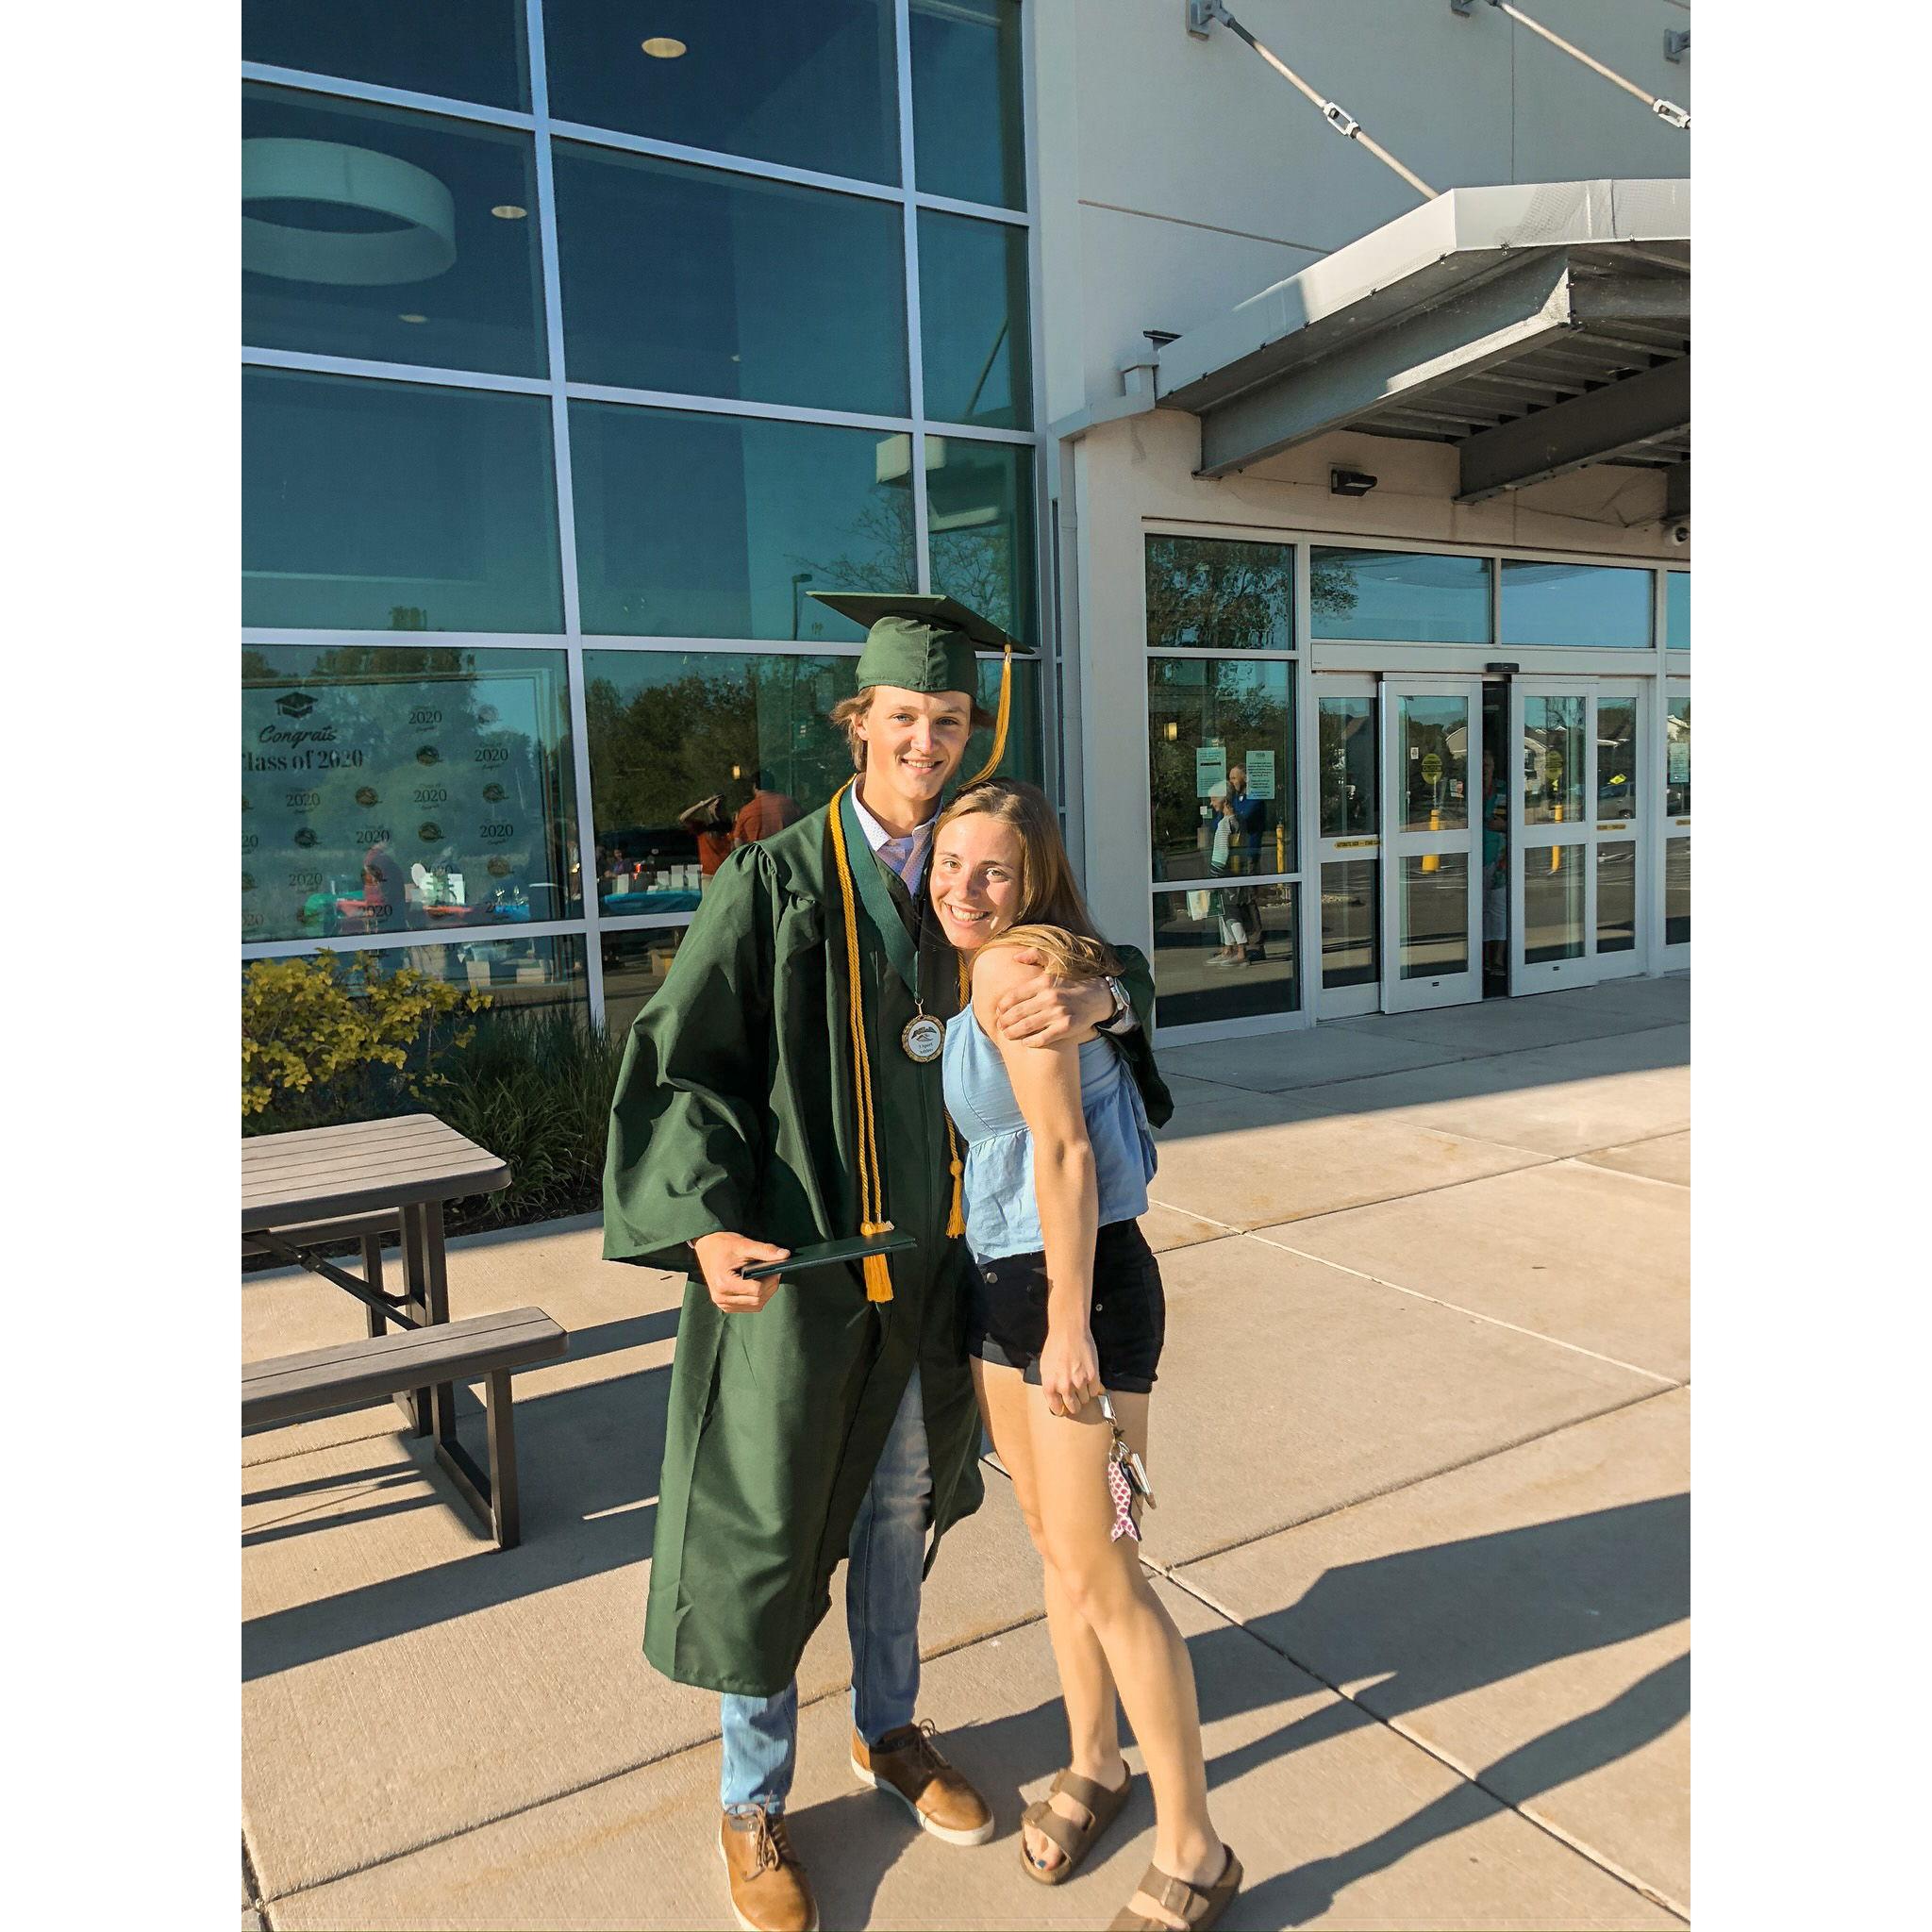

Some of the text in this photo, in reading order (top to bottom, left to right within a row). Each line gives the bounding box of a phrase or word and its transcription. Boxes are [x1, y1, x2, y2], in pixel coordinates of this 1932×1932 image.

[408, 710, 442, 724] 2020
[259, 724, 338, 749] Congrats
[242, 749, 363, 772] lass of 2020
[475, 748, 508, 762] 2020
[286, 792, 321, 808] 2020
[413, 789, 447, 803] 2020
[356, 829, 391, 843] 2020
[479, 824, 514, 839] 2020
[289, 873, 323, 887] 2020
